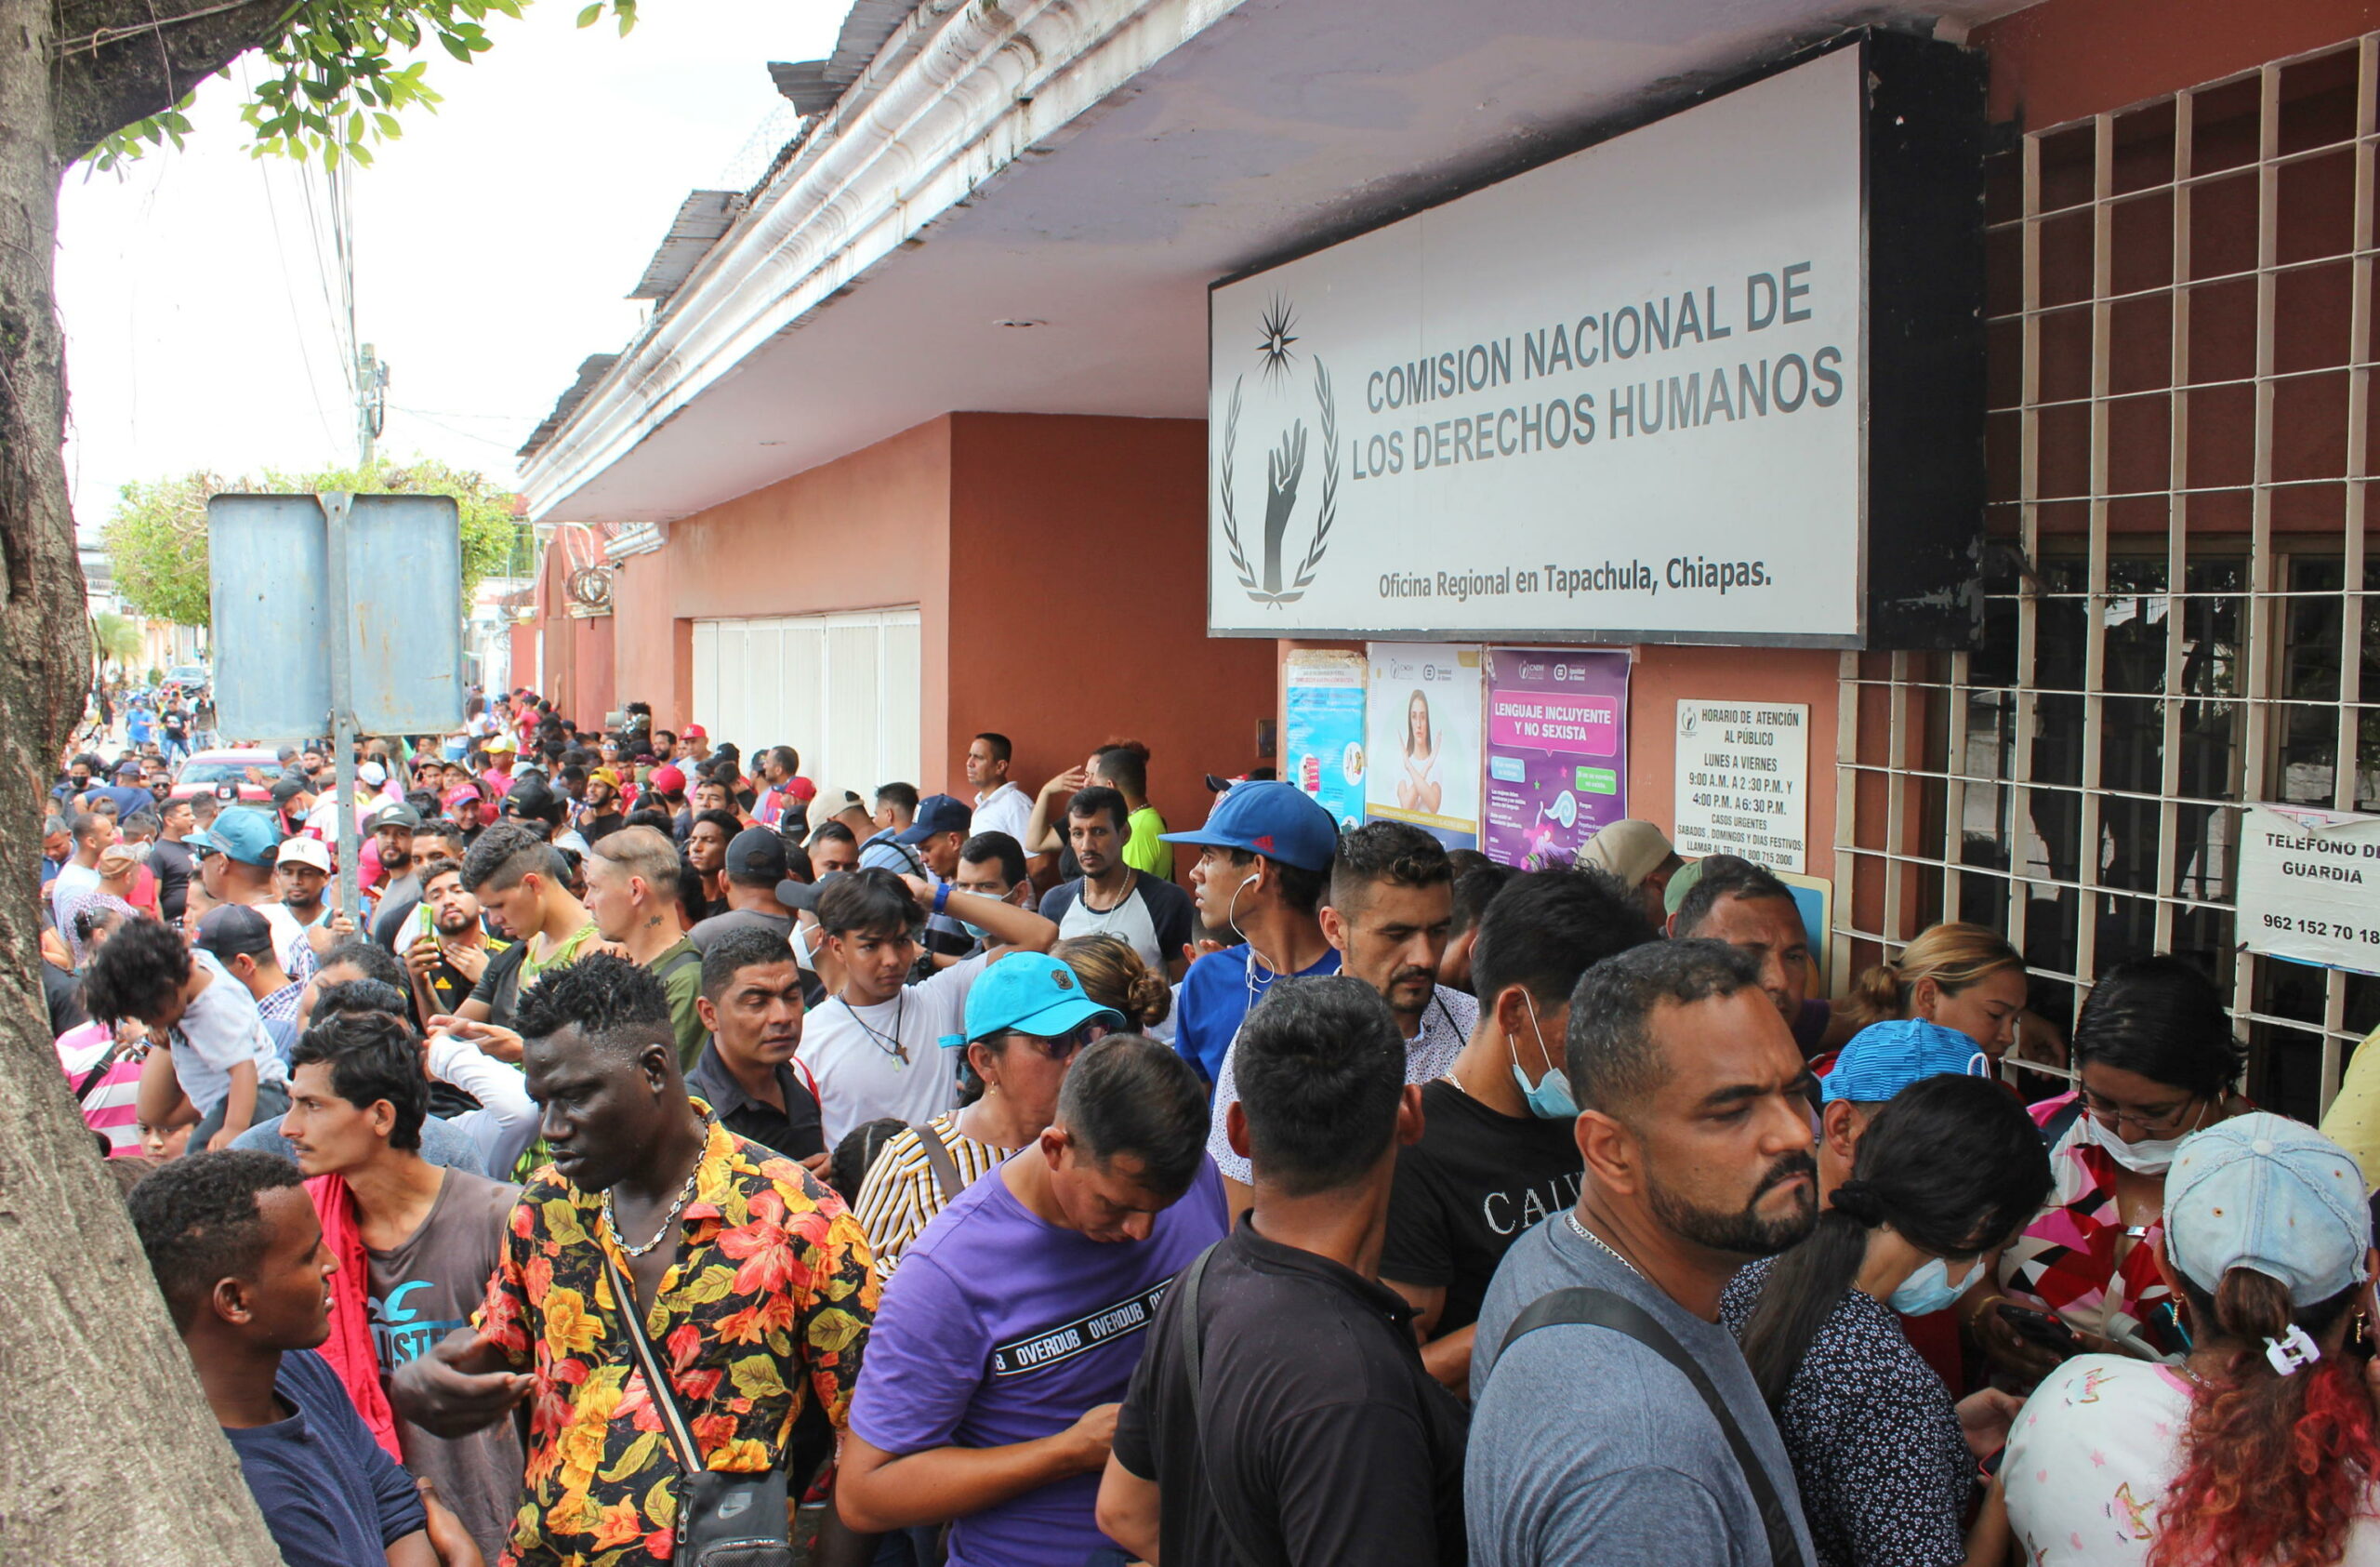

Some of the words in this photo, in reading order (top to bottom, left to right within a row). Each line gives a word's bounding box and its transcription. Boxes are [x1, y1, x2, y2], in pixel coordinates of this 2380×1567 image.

[1367, 337, 1511, 414] COMISION
[1525, 286, 1731, 380] NACIONAL
[1747, 260, 1812, 332] DE
[1353, 431, 1404, 480] LOS
[1414, 393, 1595, 471] DERECHOS
[1609, 346, 1844, 440] HUMANOS
[1379, 572, 1432, 598] Oficina
[1436, 566, 1510, 602] Regional
[1515, 573, 1539, 592] en
[1544, 559, 1659, 598] Tapachula,
[1666, 556, 1772, 595] Chiapas.
[1495, 702, 1543, 720] LENGUAJE
[1545, 706, 1611, 724] INCLUYENTE
[1701, 709, 1739, 724] HORARIO
[1740, 710, 1752, 724] DE
[1756, 708, 1799, 726] ATENCIÓN
[1514, 721, 1522, 735] Y
[1525, 722, 1540, 737] NO
[1541, 724, 1587, 740] SEXISTA
[1724, 730, 1735, 744] AL
[1737, 727, 1774, 746] PÚBLICO
[1704, 752, 1730, 768] LUNES
[1732, 755, 1739, 769] A
[1740, 755, 1778, 772] VIERNES
[1689, 772, 1708, 787] 9:00
[1709, 774, 1729, 789] A.M.
[1732, 776, 1738, 790] A
[1764, 778, 1784, 794] P.M.
[1786, 780, 1792, 795] Y
[1692, 792, 1712, 807] 4:00
[1713, 794, 1732, 809] P.M.
[1766, 801, 1787, 816] P.M.
[1712, 813, 1732, 826] CASOS
[1733, 817, 1767, 830] URGENTES
[1711, 829, 1745, 843] DOMINGOS
[1747, 833, 1752, 843] Y
[1752, 833, 1768, 846] DIAS
[1686, 840, 1712, 854] LLAMAR
[1748, 848, 1761, 861] 800
[1762, 851, 1775, 863] 715
[1776, 853, 1793, 866] 2000
[2282, 861, 2362, 883] GUARDIA
[2263, 914, 2293, 931] 962
[2297, 919, 2327, 936] 152
[2333, 924, 2353, 940] 70
[2360, 929, 2380, 945] 18
[1015, 1328, 1082, 1366] OVERDUB
[1088, 1302, 1145, 1340] OVERDUB
